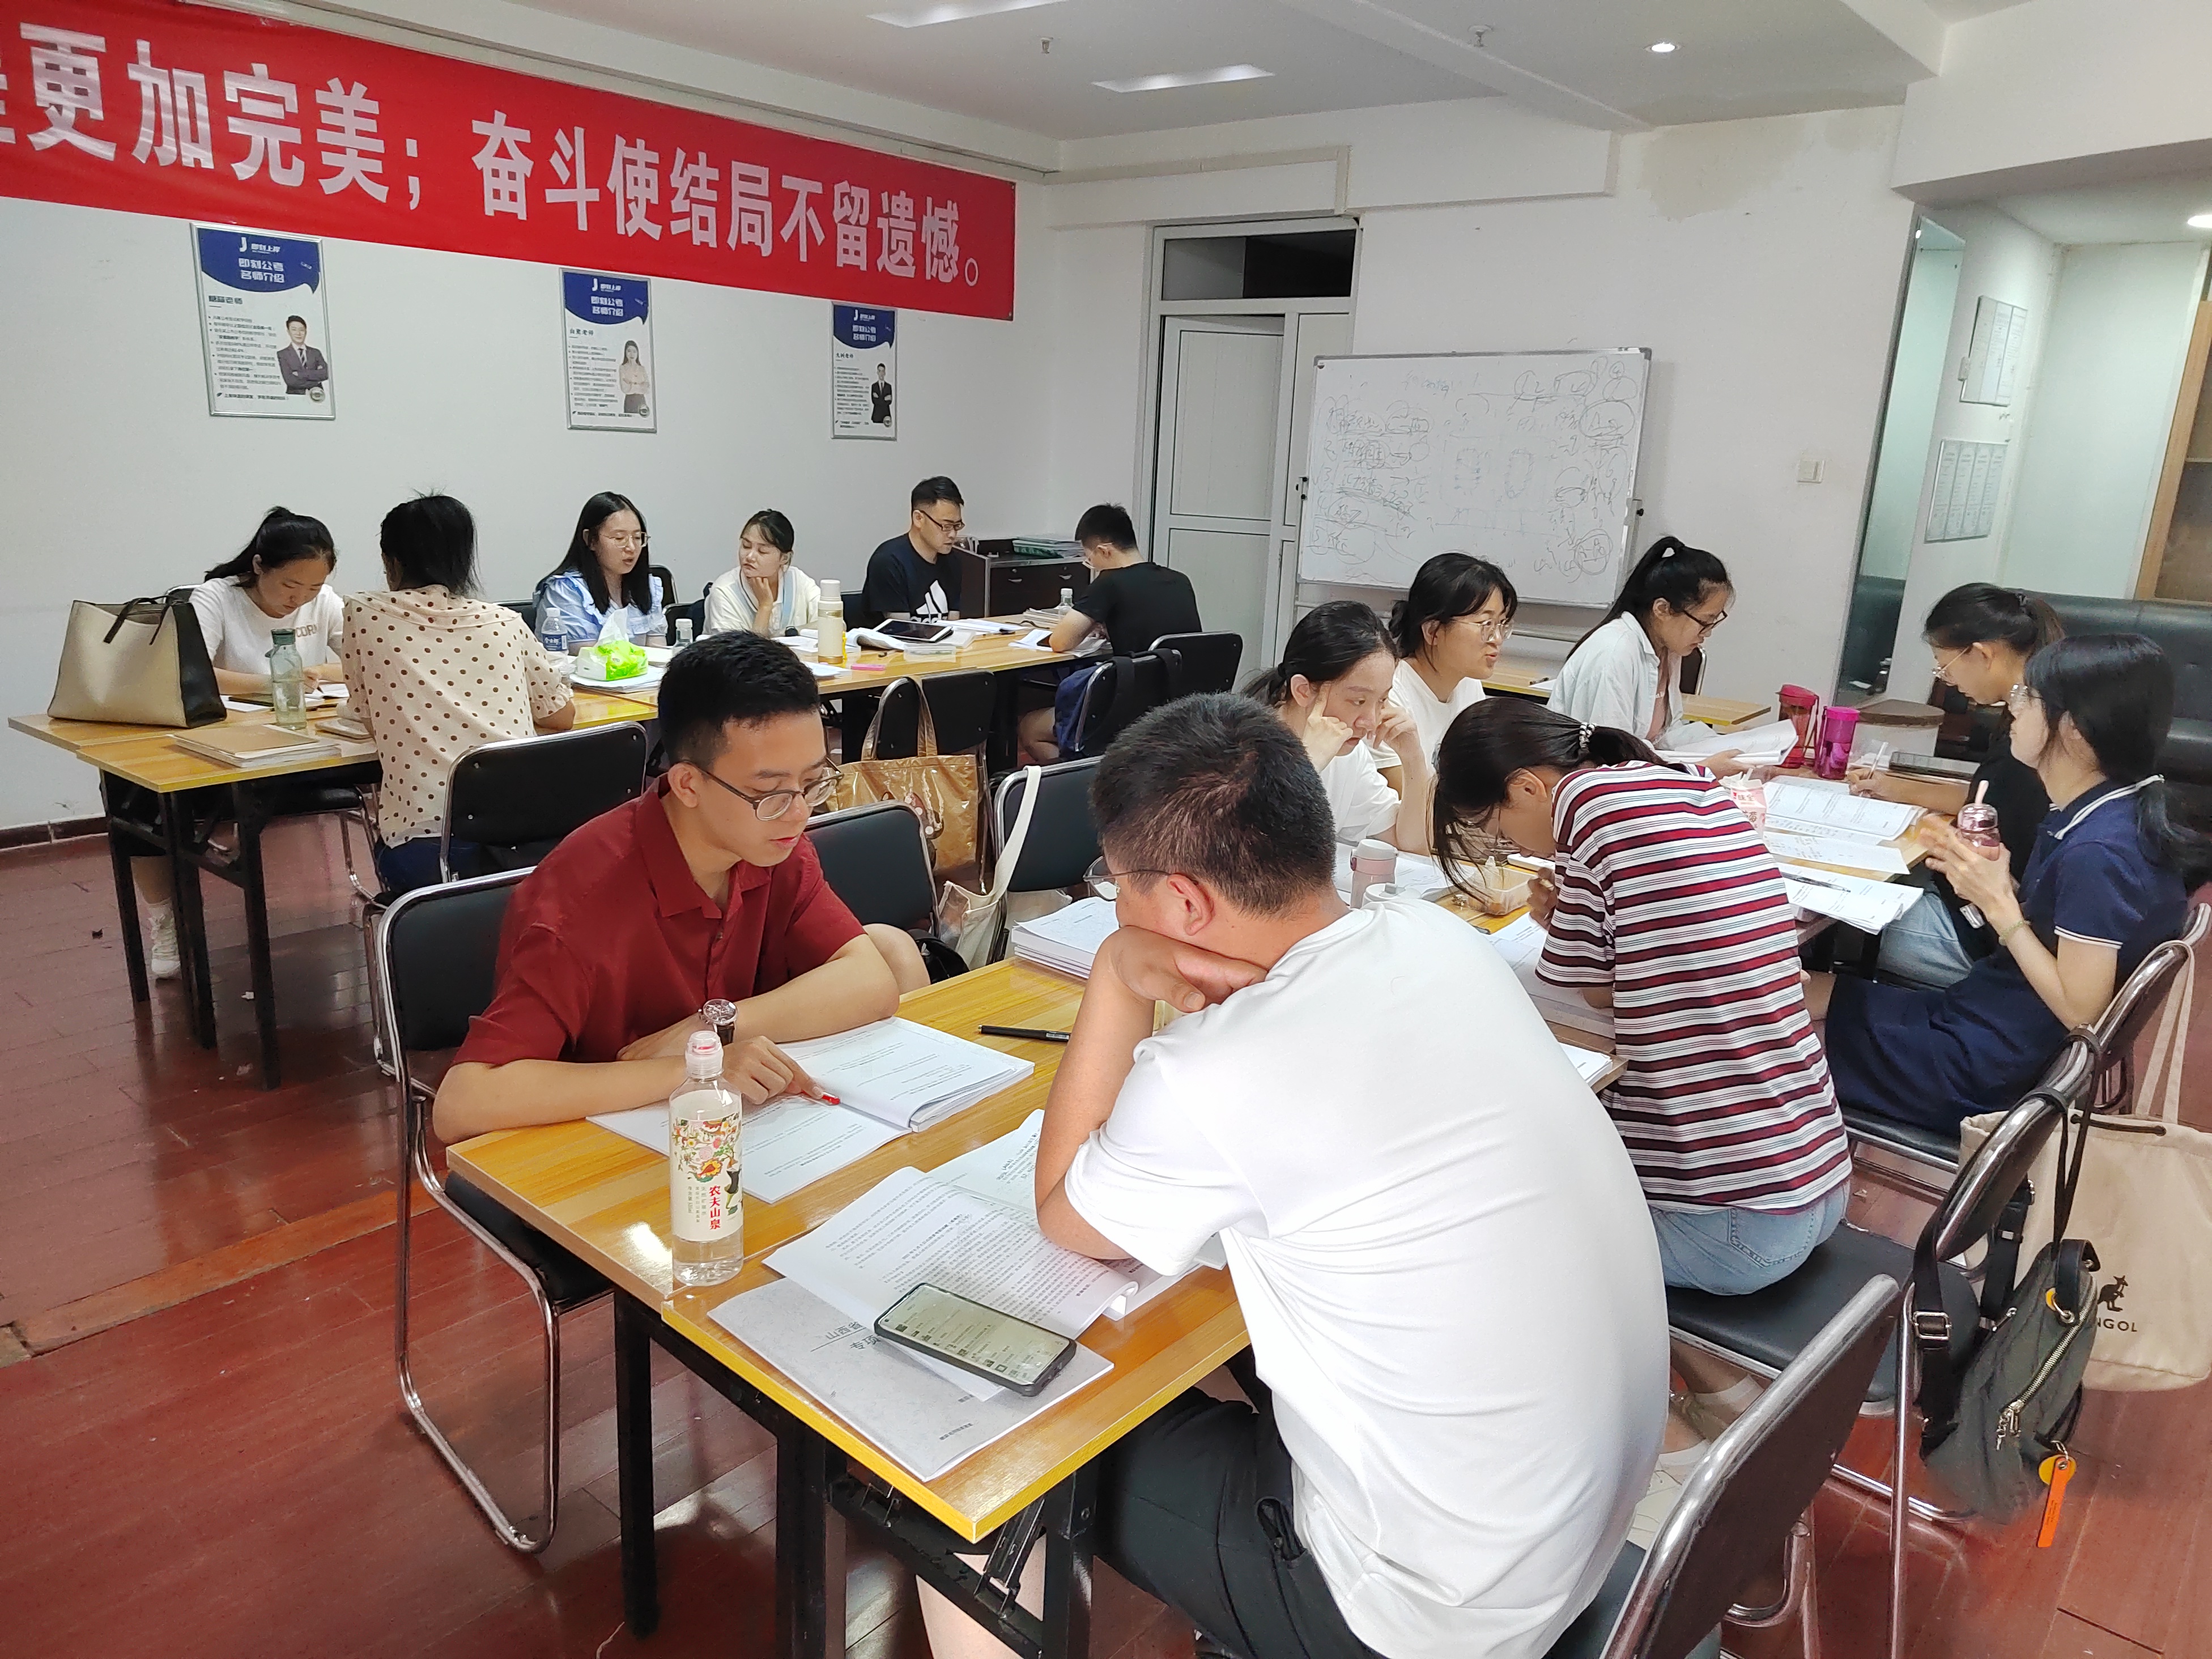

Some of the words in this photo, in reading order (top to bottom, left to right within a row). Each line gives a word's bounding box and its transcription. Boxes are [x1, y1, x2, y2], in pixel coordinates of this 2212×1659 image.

[0, 22, 979, 287] 更加完美；奋斗使结局不留遗憾。
[238, 258, 284, 271] 即刻公考
[240, 269, 284, 283] 名师介绍
[709, 1185, 721, 1230] 农夫山泉
[826, 1321, 863, 1339] 山西省
[850, 1335, 882, 1349] 专项
